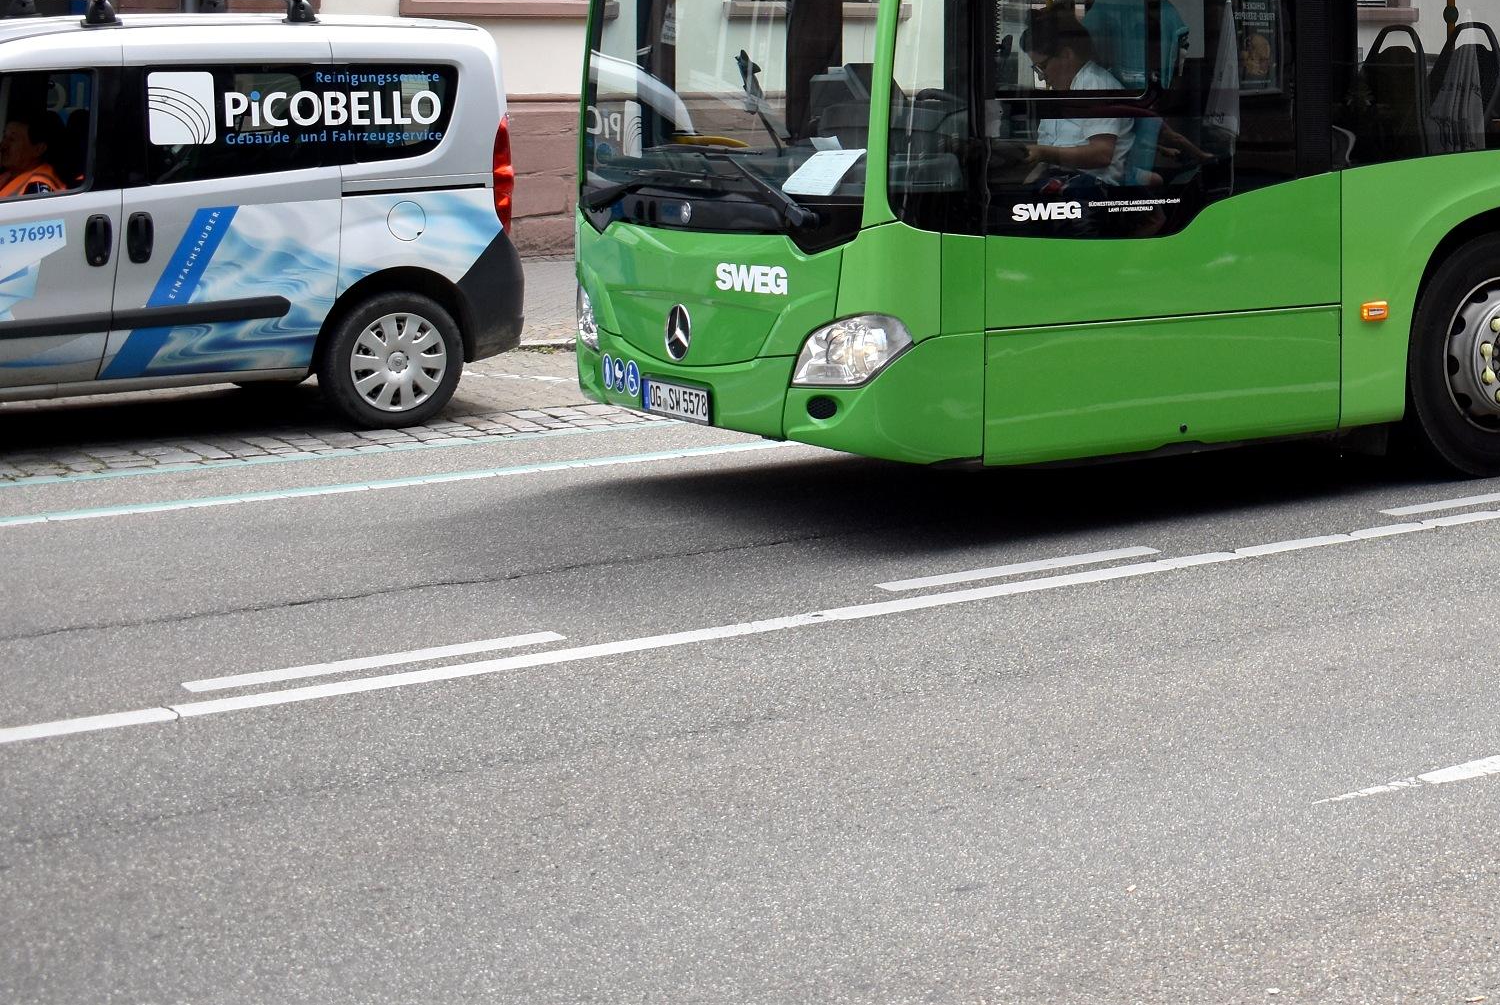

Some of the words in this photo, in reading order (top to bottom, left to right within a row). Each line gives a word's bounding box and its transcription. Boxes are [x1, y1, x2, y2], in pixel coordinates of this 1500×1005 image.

[315, 71, 440, 86] Reinigungsservice
[225, 131, 290, 145] Gebäude
[300, 130, 328, 143] und
[332, 130, 443, 144] Fahrzeugservice
[1011, 201, 1082, 222] SWEG
[9, 224, 63, 244] 376991
[715, 262, 788, 295] SWEG
[650, 384, 662, 408] OG
[669, 387, 681, 413] SW
[682, 390, 708, 417] 5578
